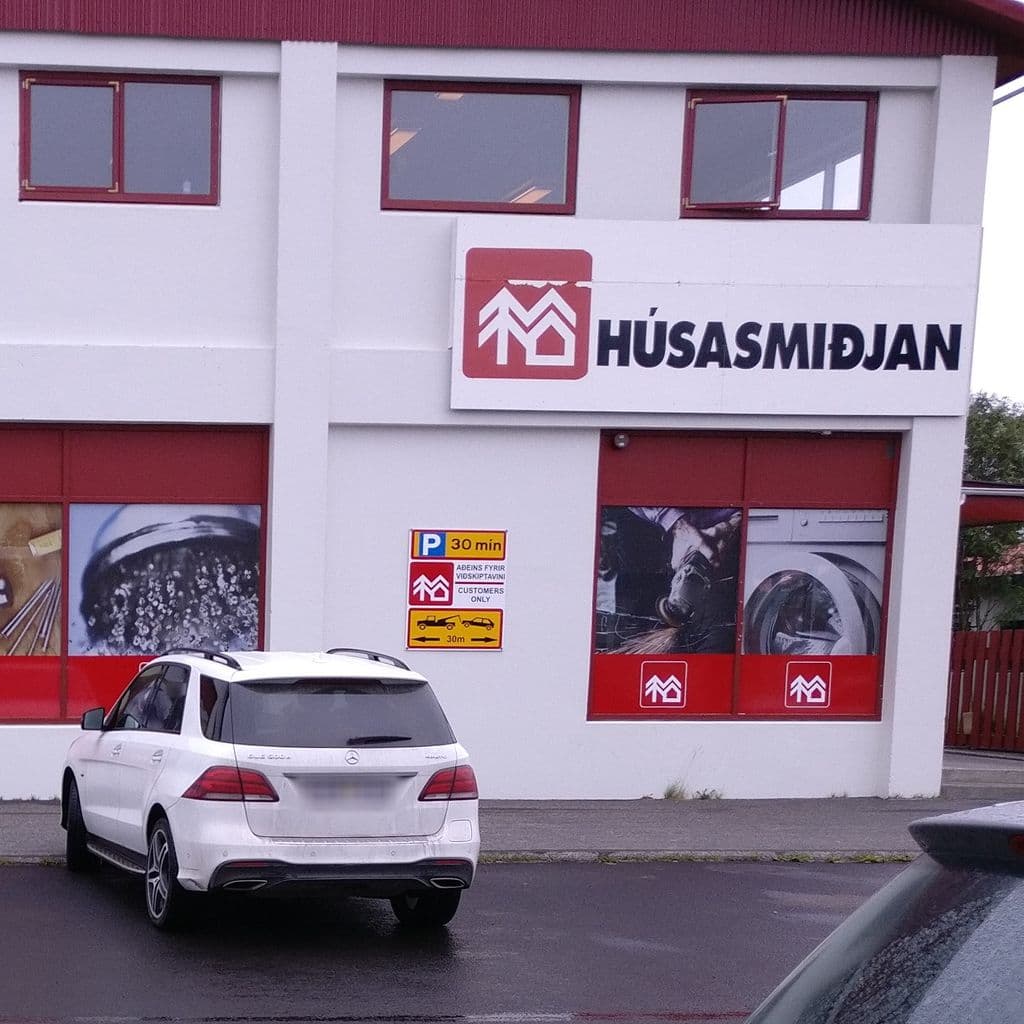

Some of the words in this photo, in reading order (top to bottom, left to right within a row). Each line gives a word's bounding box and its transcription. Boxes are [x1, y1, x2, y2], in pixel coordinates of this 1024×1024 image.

[596, 308, 962, 371] HÚSASMIÐJAN
[422, 533, 441, 556] P
[451, 538, 472, 551] 30
[470, 595, 491, 603] ONLY
